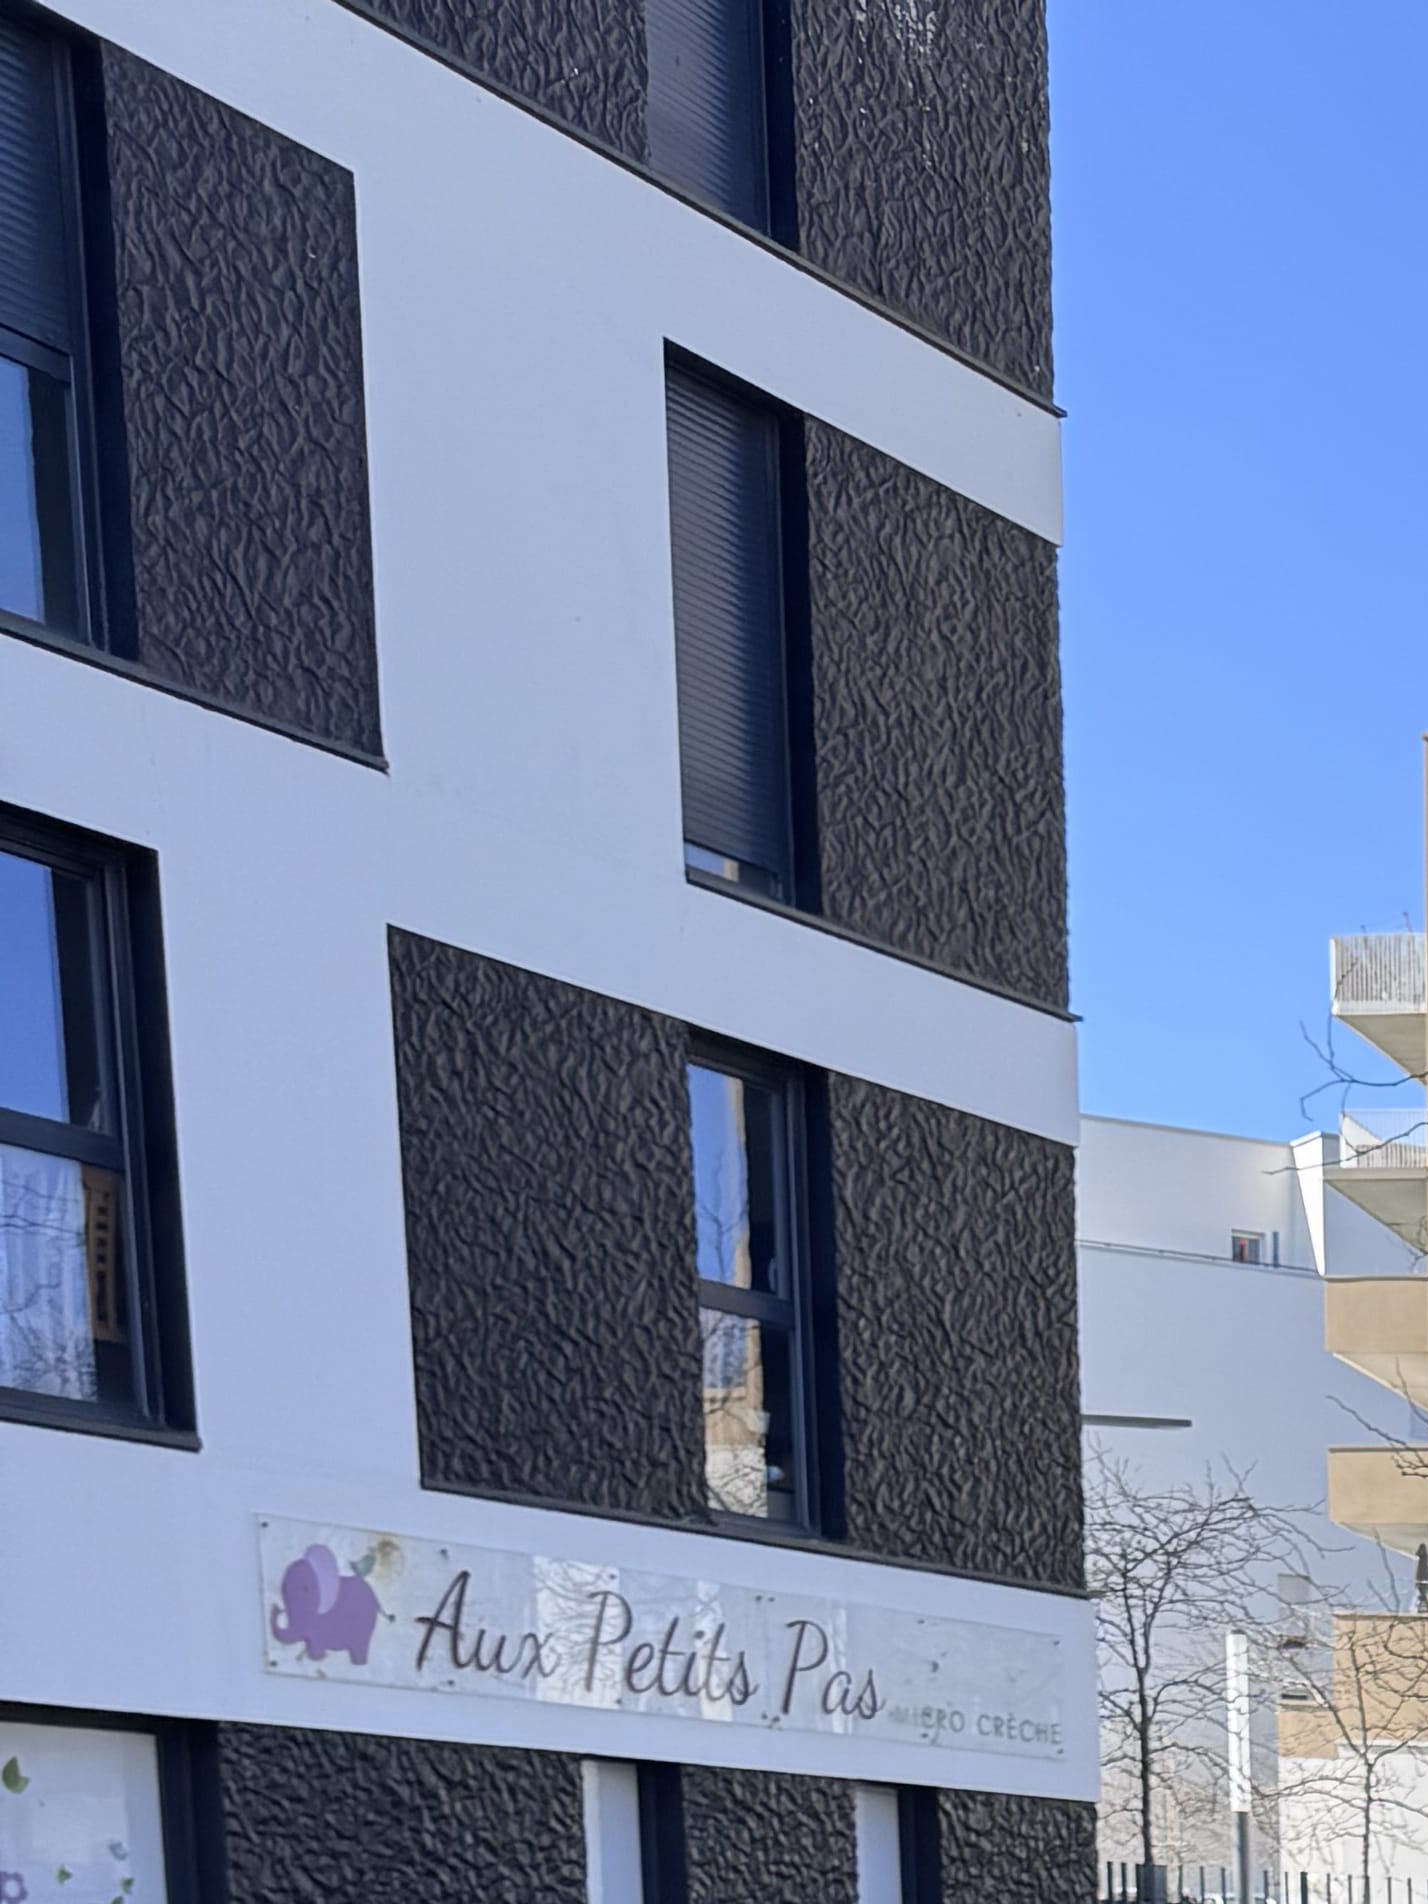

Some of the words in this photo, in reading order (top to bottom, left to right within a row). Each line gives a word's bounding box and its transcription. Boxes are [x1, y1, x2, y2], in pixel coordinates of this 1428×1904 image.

[415, 1569, 560, 1678] Aux
[584, 1590, 759, 1707] Petits
[781, 1619, 887, 1720] Pas
[976, 1712, 1063, 1746] CRÈCHE
